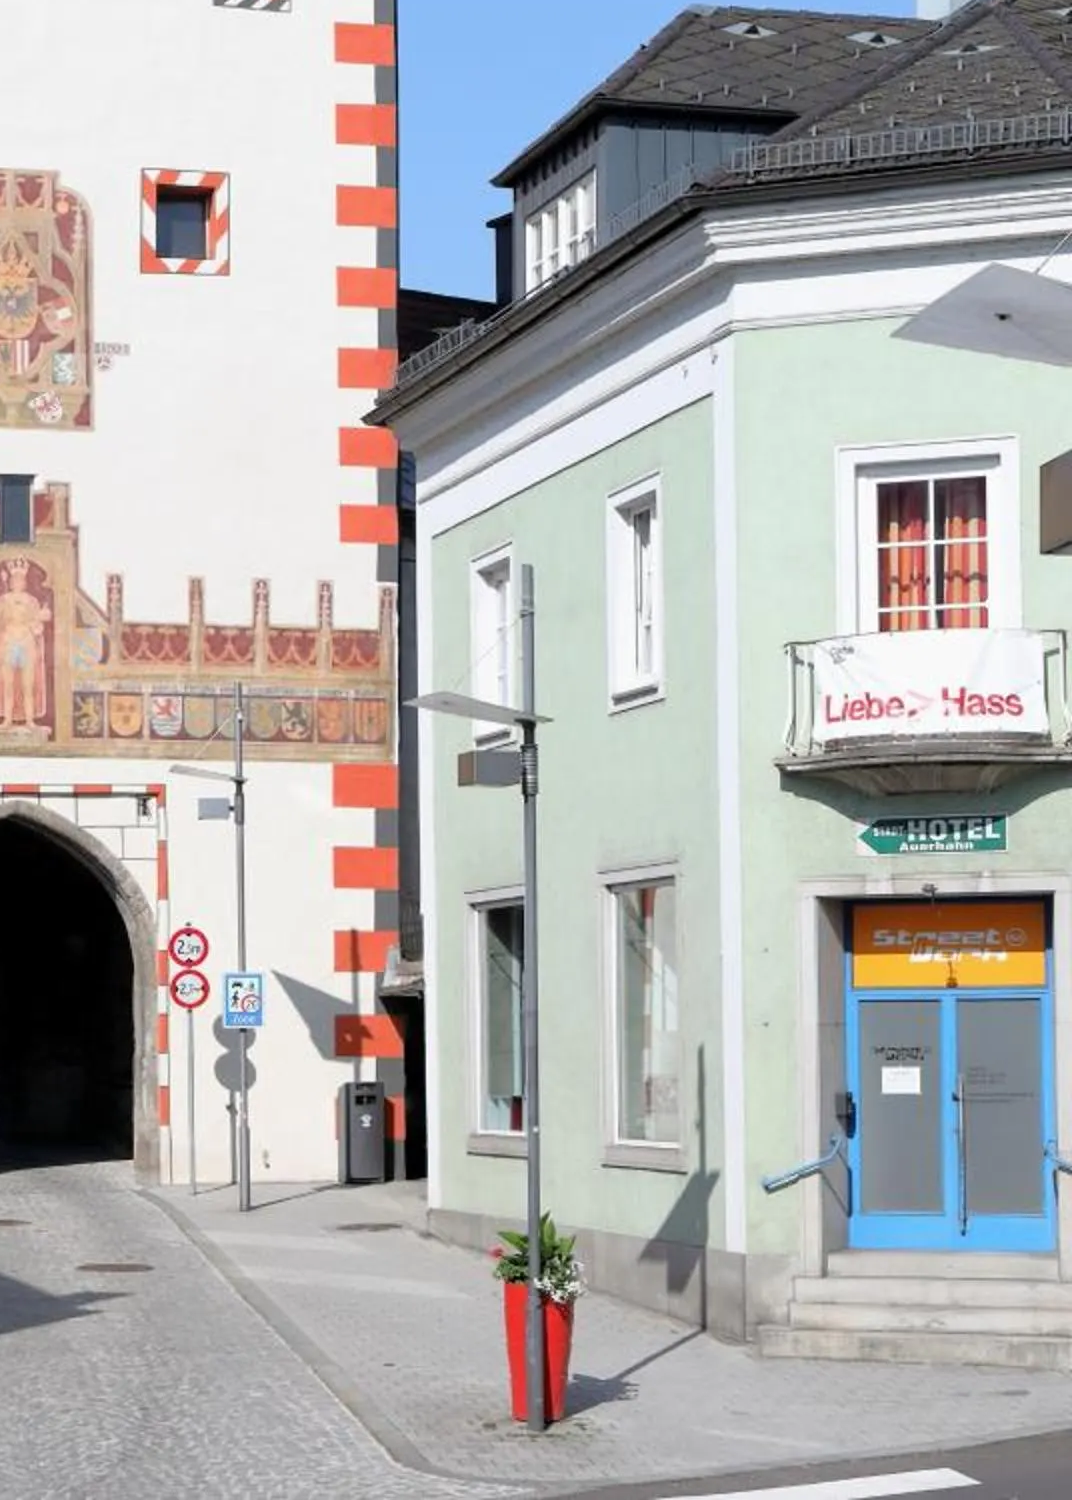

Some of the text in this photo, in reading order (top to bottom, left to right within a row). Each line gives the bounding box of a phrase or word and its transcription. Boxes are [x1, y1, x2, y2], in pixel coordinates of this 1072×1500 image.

[825, 692, 905, 724] Liebe
[941, 686, 1024, 717] Hass
[907, 816, 1001, 842] HOTEL
[899, 840, 974, 853] Auerhahn
